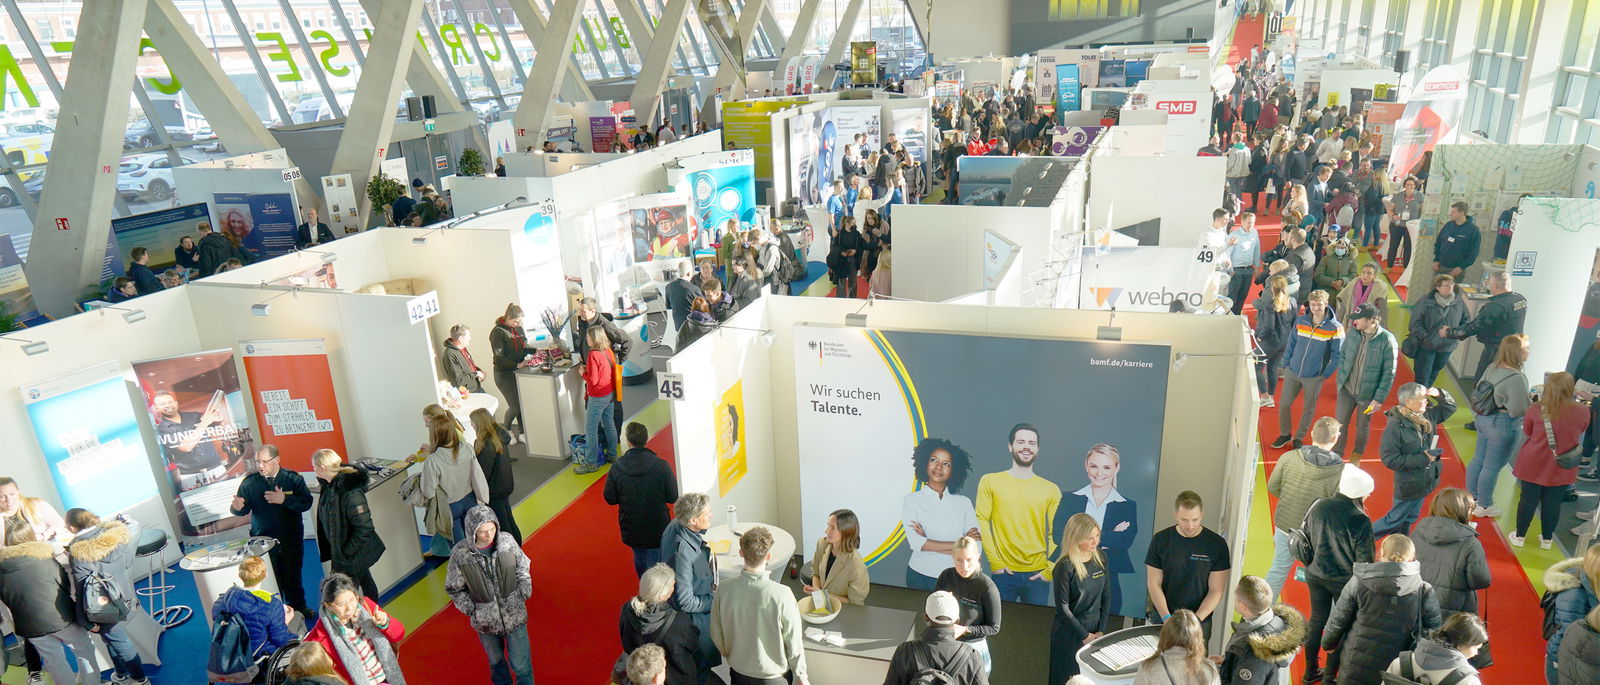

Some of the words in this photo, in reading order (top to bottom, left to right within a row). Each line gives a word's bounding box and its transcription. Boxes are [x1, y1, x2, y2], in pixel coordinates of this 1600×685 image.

[787, 65, 795, 80] GRG
[805, 65, 813, 80] GRG
[1424, 81, 1458, 91] REMONDIS
[1158, 102, 1194, 112] SMB
[541, 204, 553, 215] 39
[1197, 250, 1214, 263] 49
[411, 304, 424, 320] 42
[425, 298, 438, 314] 41
[1090, 358, 1154, 368] bamf.de/karriere
[660, 380, 684, 399] 45
[809, 383, 833, 397] Wir
[836, 387, 881, 401] suchen
[268, 402, 281, 413] EIN
[282, 400, 304, 411] SCHIFF
[810, 400, 862, 416] Talente.
[266, 413, 281, 424] ZUM
[282, 411, 315, 423] STRAHLEN
[274, 424, 284, 435] ZU
[284, 421, 316, 434] BRINGEN?
